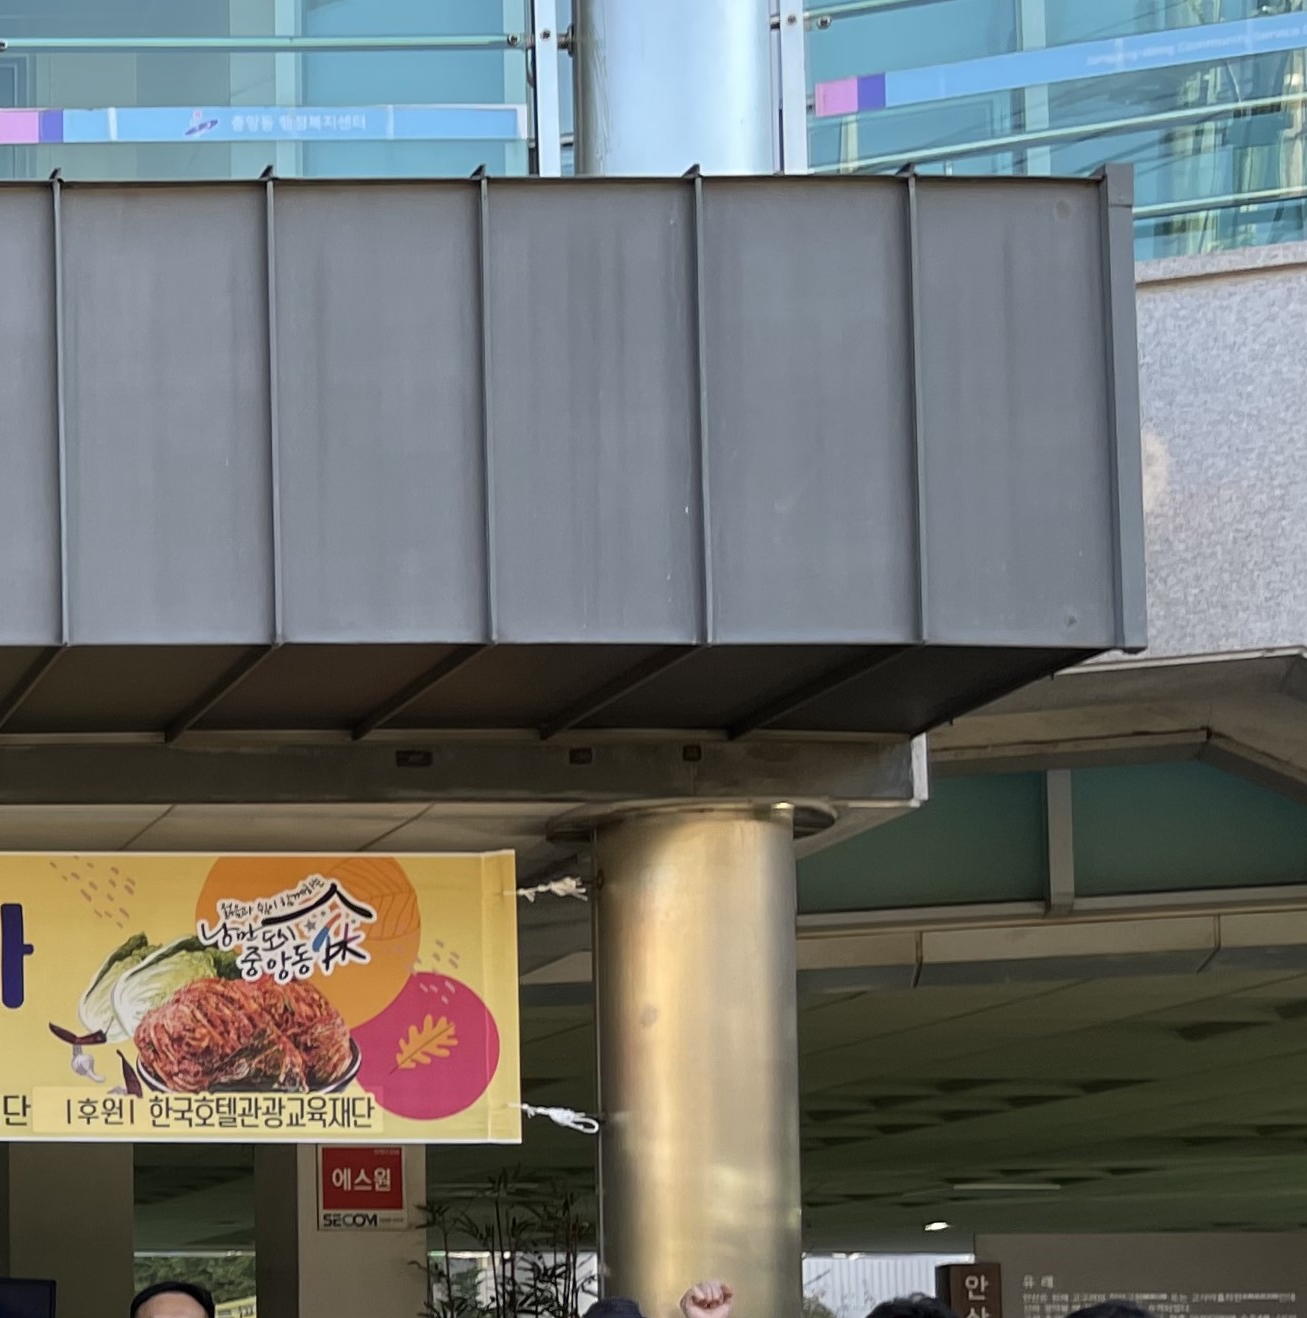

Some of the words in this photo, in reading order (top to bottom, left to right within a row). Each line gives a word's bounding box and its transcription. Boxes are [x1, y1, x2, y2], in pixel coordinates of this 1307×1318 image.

[241, 944, 314, 980] 중앙동
[148, 1095, 377, 1130] 한국호텔관광교육재단
[331, 1167, 392, 1192] 에스원
[323, 1213, 378, 1228] SECOM
